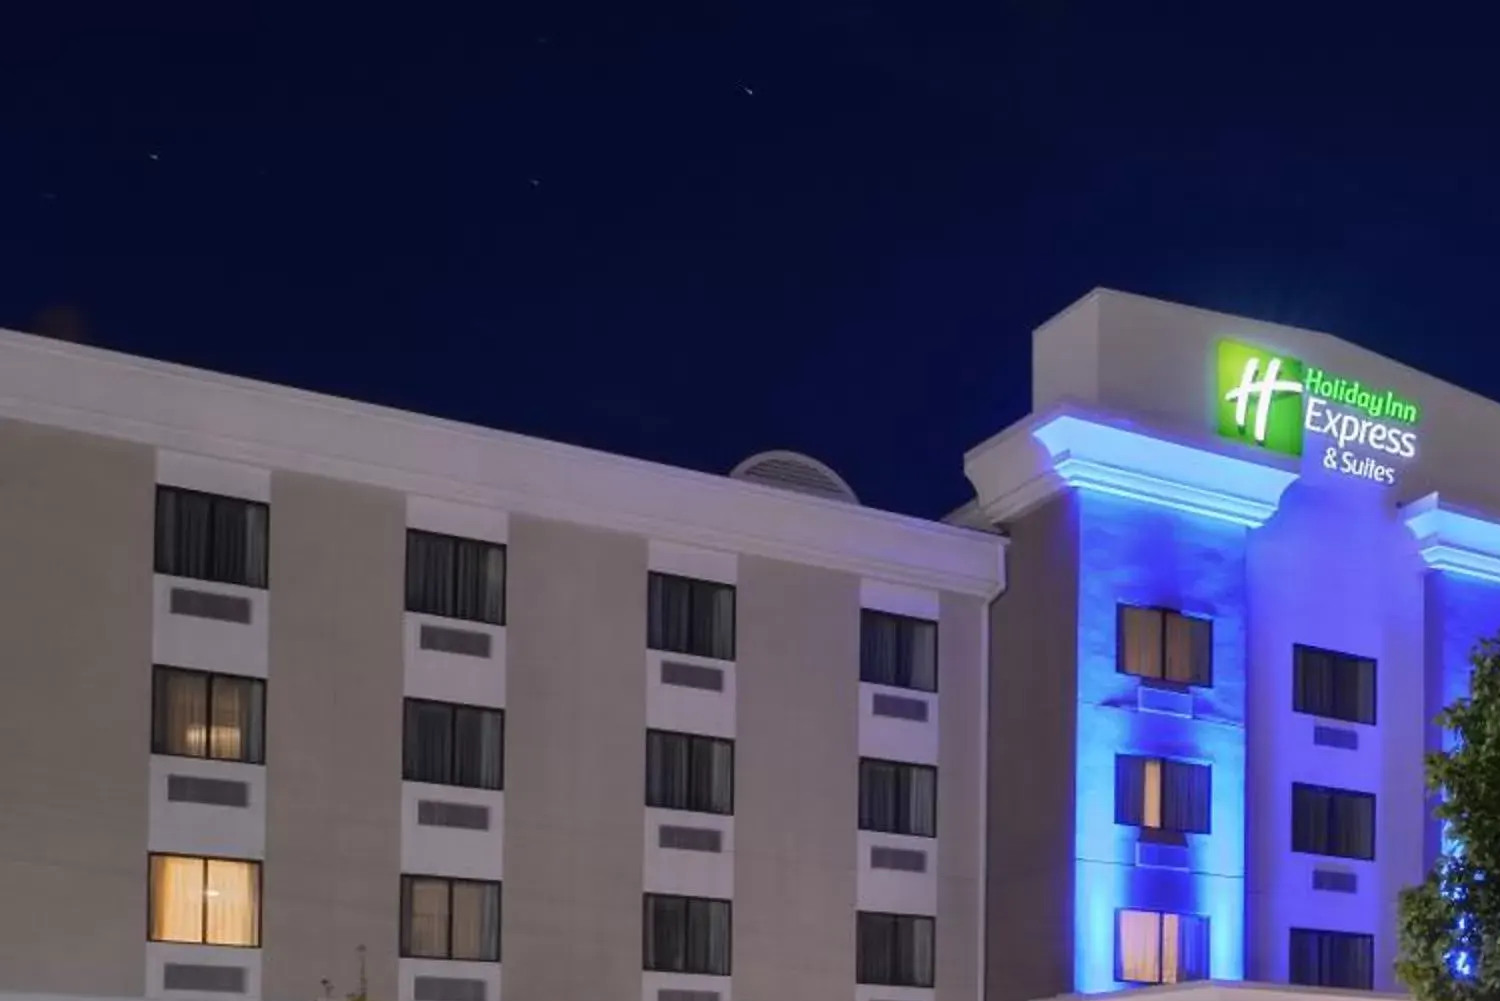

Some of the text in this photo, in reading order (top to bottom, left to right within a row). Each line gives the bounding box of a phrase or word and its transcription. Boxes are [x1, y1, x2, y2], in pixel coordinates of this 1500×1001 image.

[1304, 367, 1417, 422] Holiday Inn
[1304, 396, 1417, 458] Express
[1323, 447, 1396, 484] & Suites
